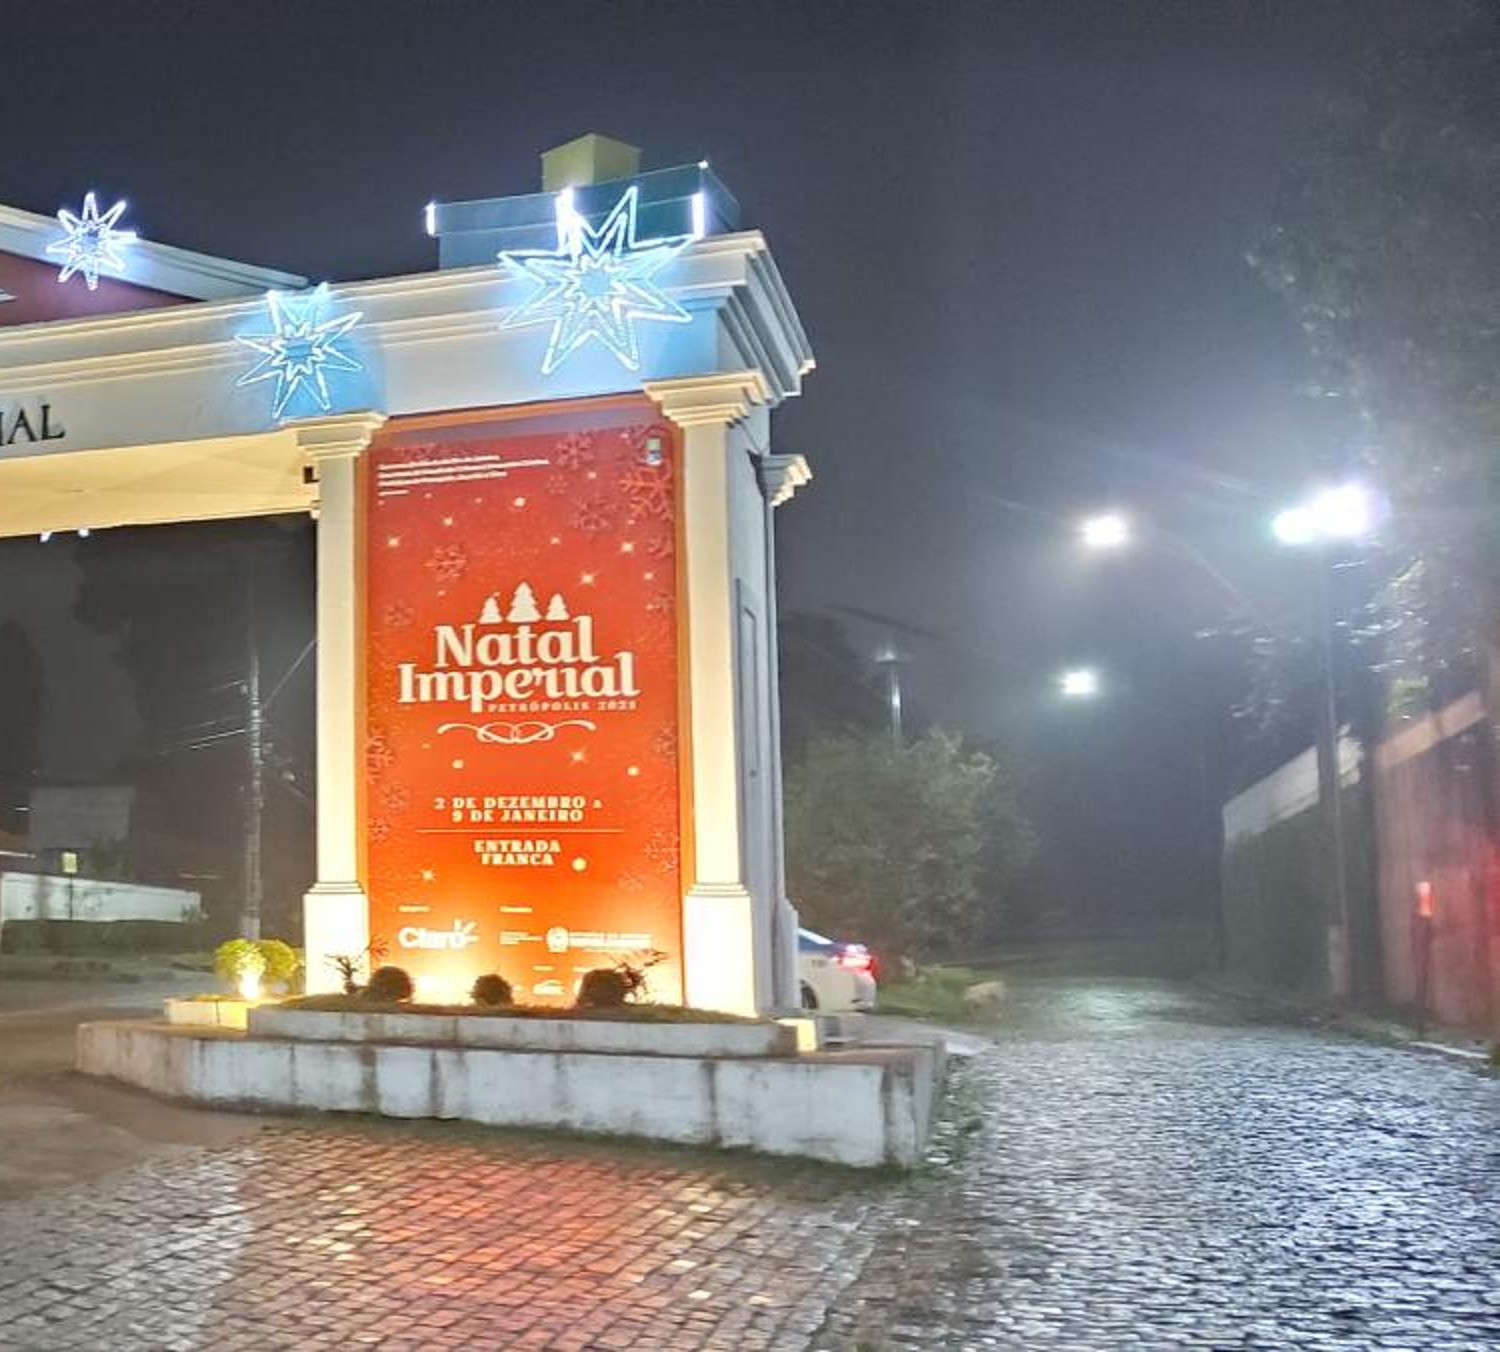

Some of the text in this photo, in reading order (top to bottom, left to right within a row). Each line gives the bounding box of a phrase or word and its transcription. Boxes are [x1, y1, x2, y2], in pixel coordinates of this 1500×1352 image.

[434, 615, 600, 668] Natal
[397, 651, 641, 713] Imperial
[453, 797, 477, 809] DE
[484, 795, 586, 809] DEZEMBRO
[452, 809, 584, 823] 9 DE JANEIRO
[474, 839, 562, 853] ENTRADA
[481, 853, 555, 866] FRANCA
[398, 926, 469, 949] Claro
